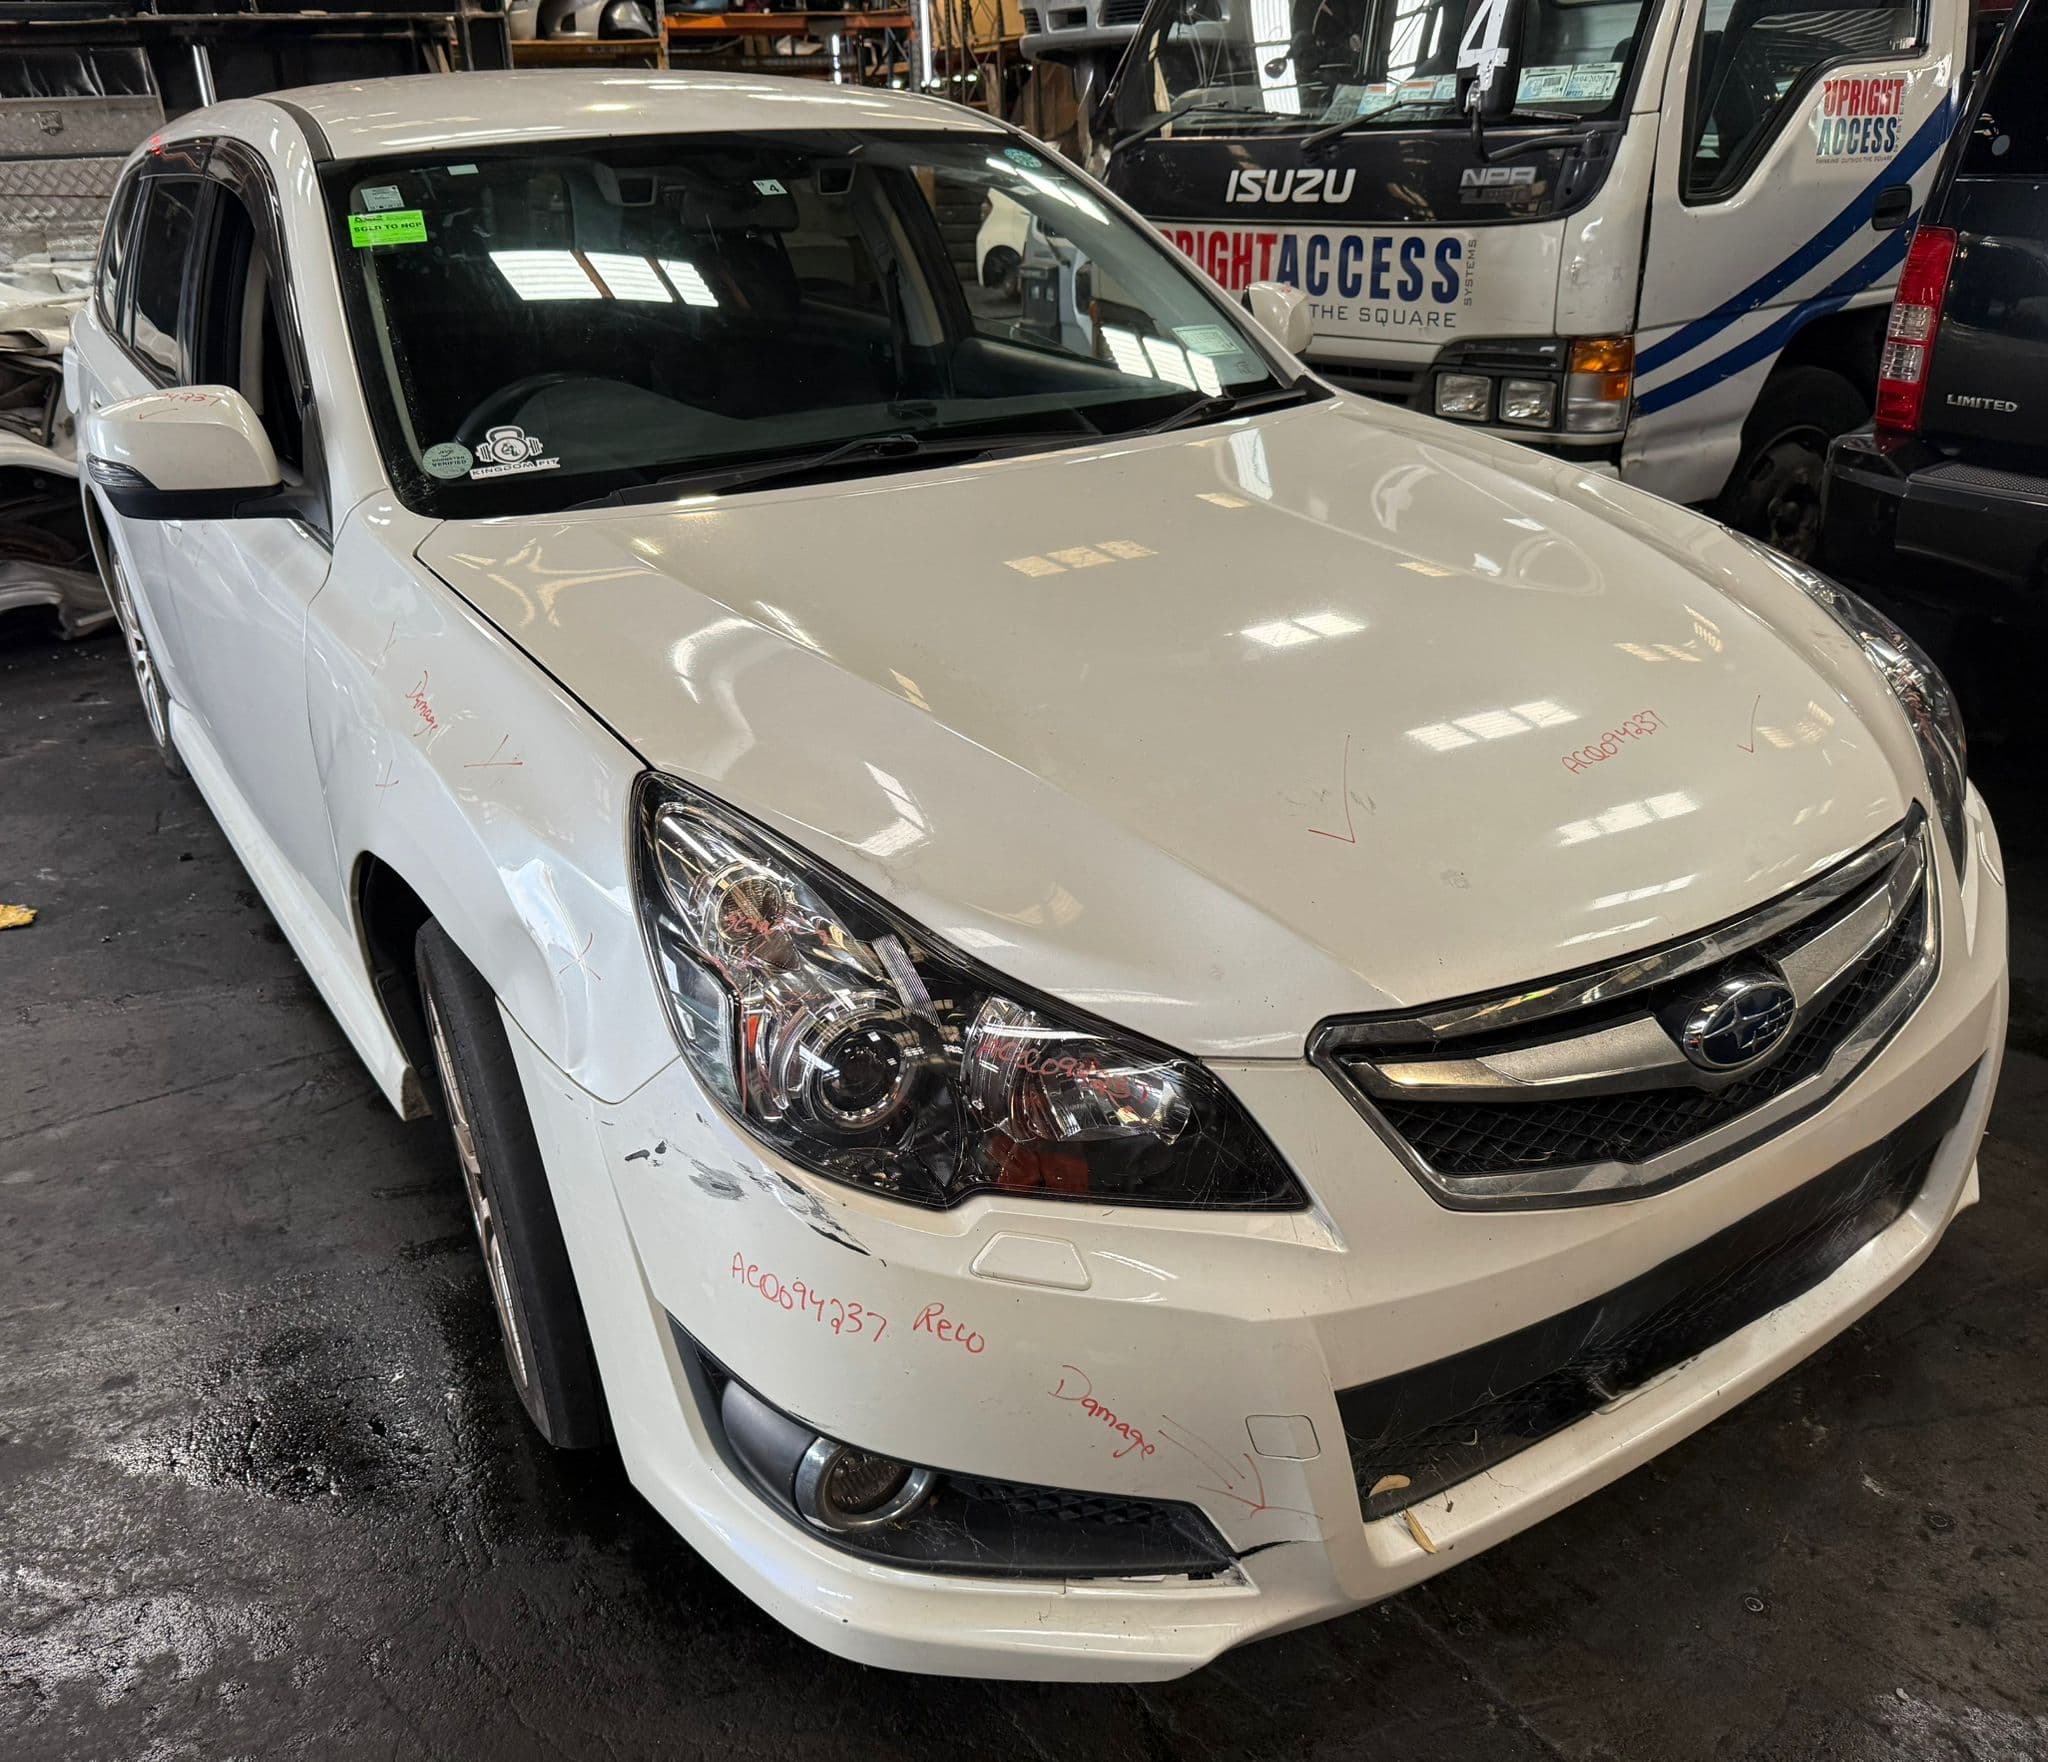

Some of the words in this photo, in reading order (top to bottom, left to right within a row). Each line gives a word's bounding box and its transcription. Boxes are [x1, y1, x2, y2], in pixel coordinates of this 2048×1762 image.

[1456, 0, 1509, 91] 4
[1823, 79, 1904, 116] UPRIGHT
[1816, 117, 1897, 155] ACCESS
[1226, 168, 1356, 203] ISUZU
[1460, 166, 1537, 187] NPR
[1277, 234, 1462, 304] ACCESS
[1464, 239, 1477, 307] SYSTEMS
[1309, 303, 1349, 321] THE
[1359, 307, 1457, 329] SQUARE
[1947, 394, 2018, 412] LIMITED
[471, 461, 534, 476] KINGDOM
[1047, 1364, 1156, 1460] Damage
